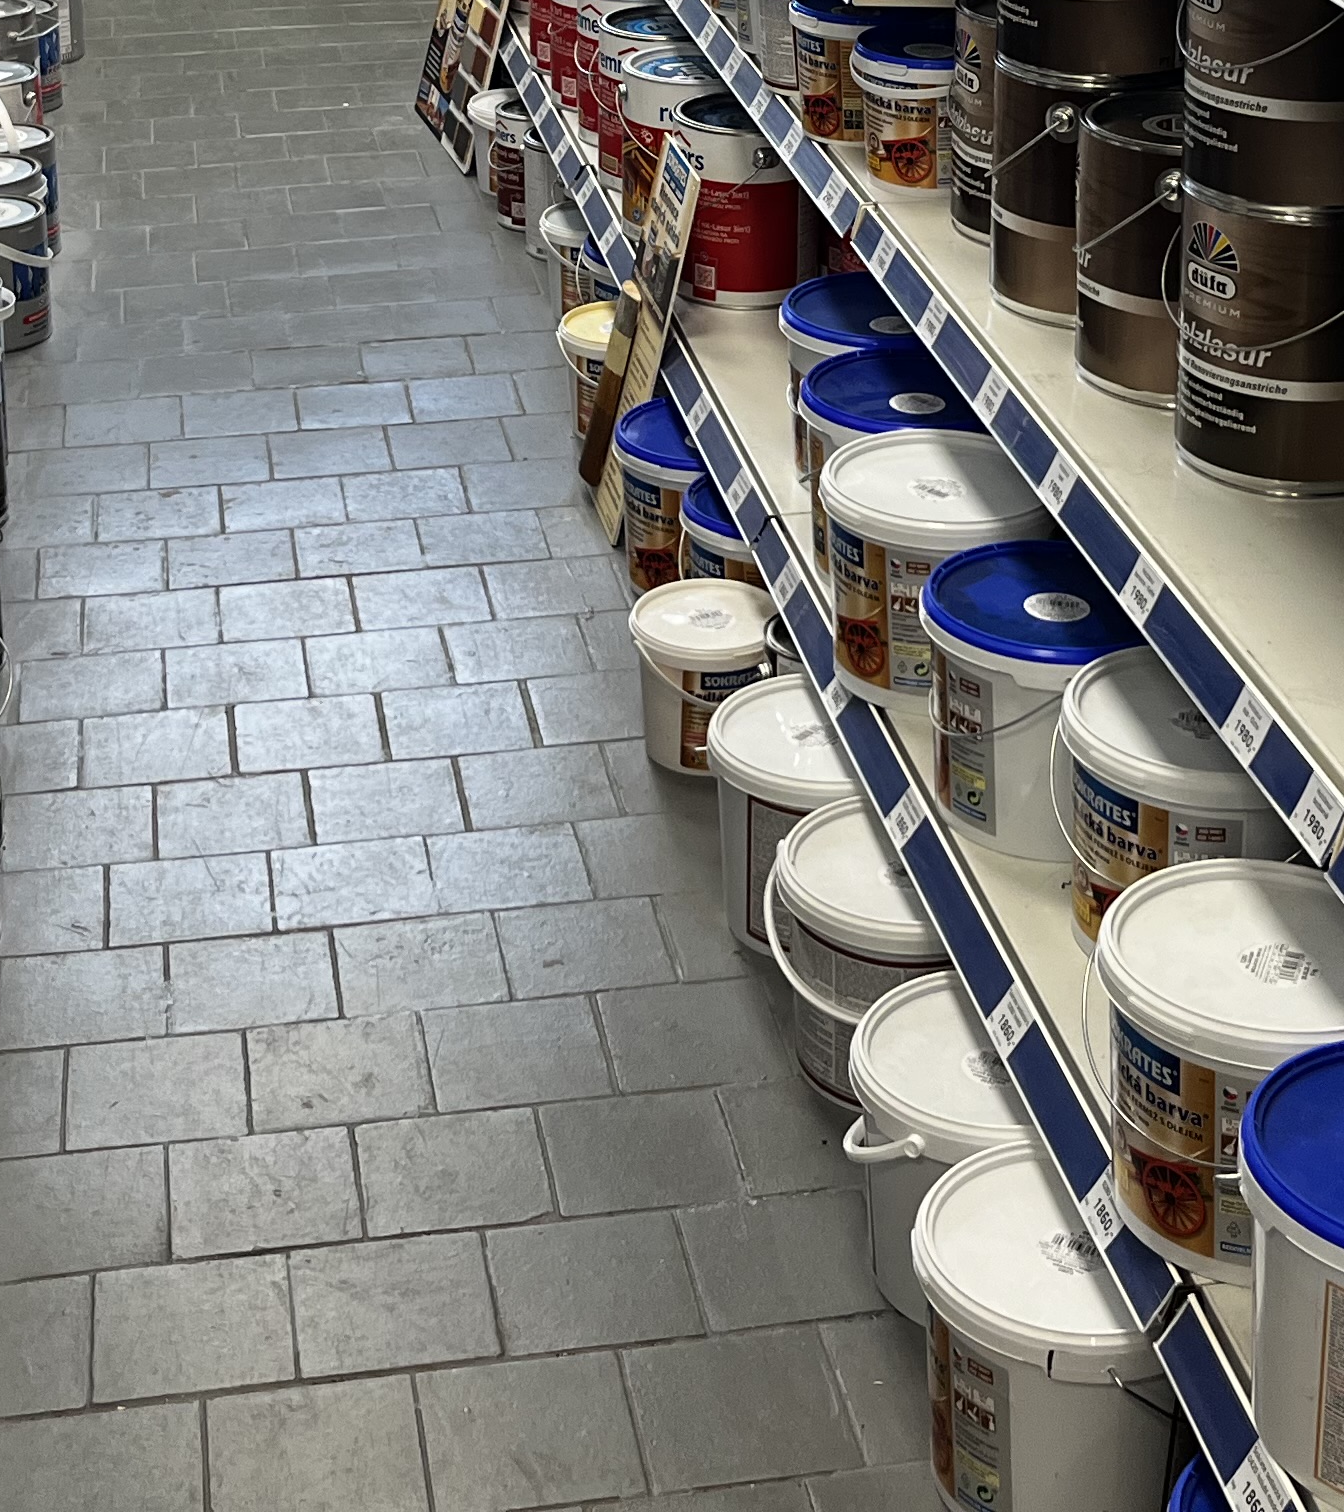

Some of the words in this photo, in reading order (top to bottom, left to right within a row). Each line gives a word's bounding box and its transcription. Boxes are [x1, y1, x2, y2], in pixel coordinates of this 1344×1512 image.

[1189, 264, 1230, 297] düfa
[1304, 808, 1327, 846] 1980,-
[1145, 1089, 1203, 1129] barva
